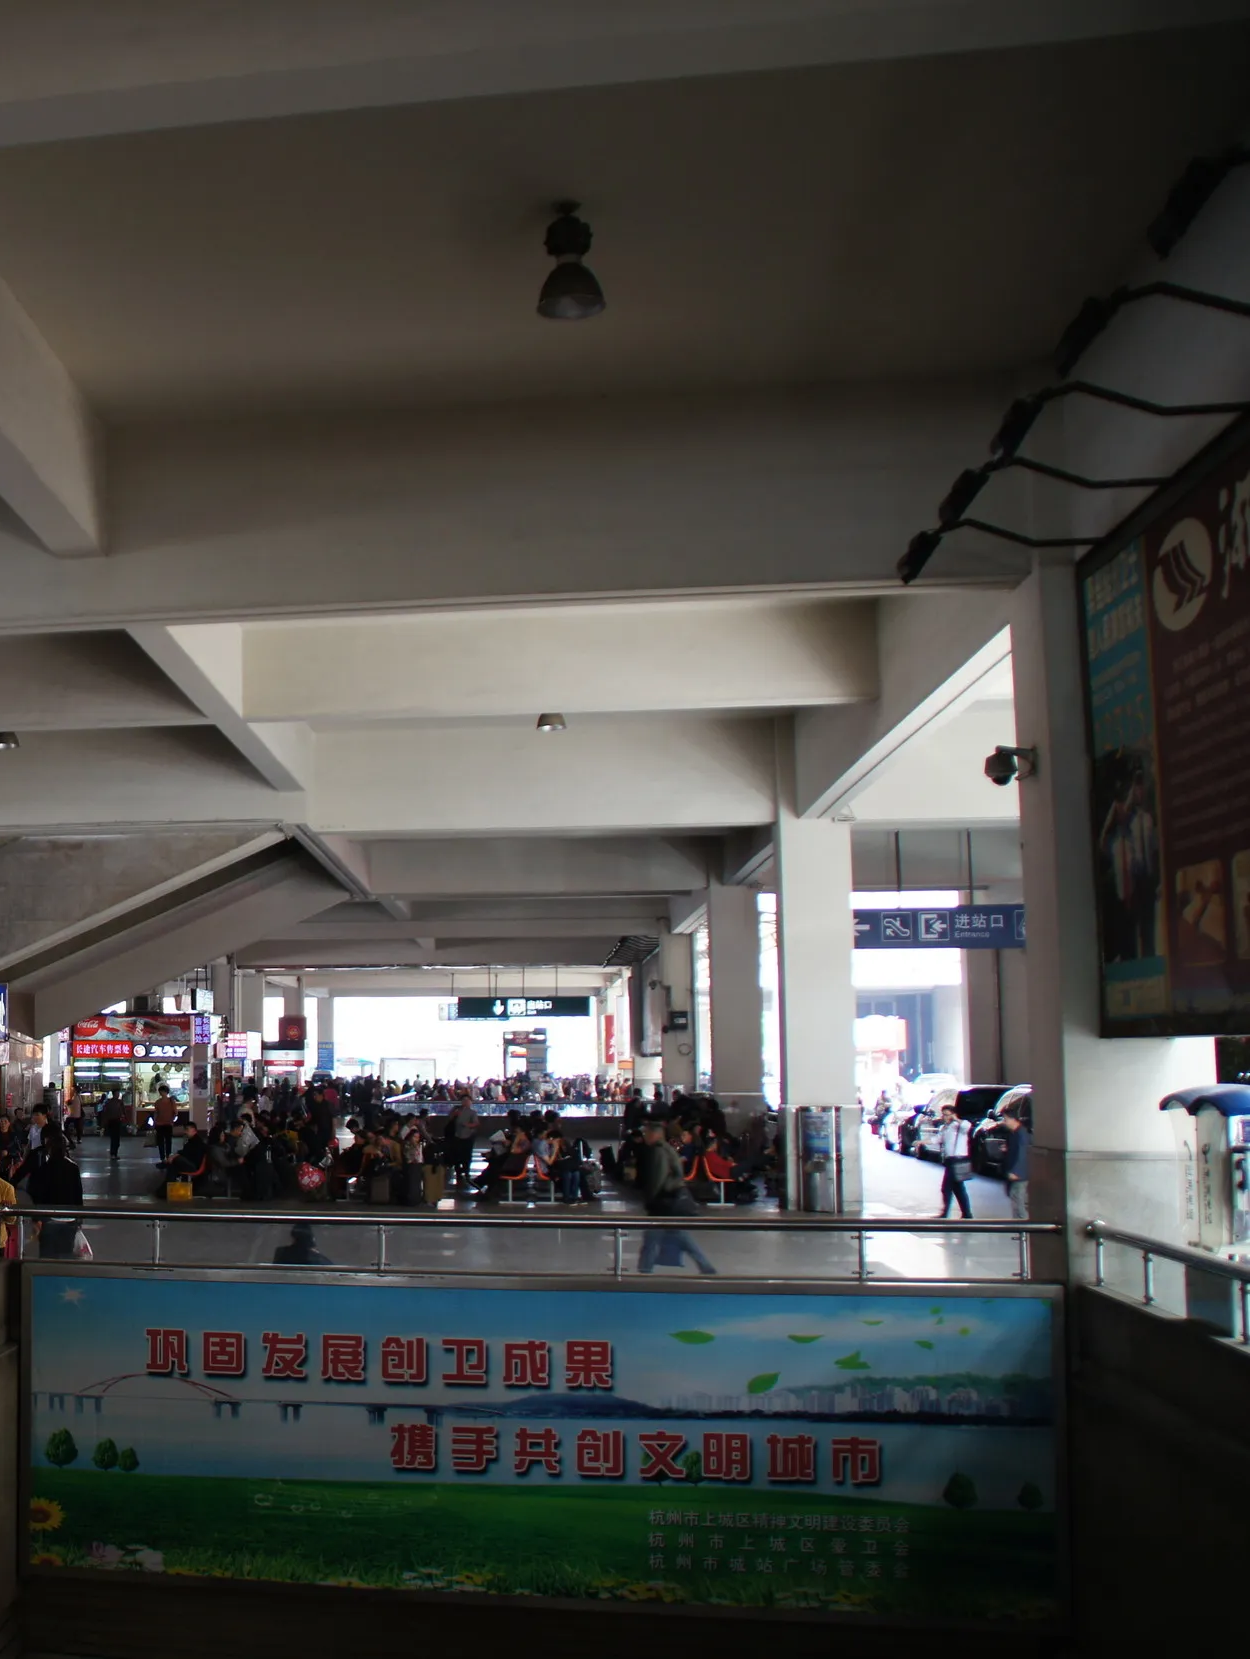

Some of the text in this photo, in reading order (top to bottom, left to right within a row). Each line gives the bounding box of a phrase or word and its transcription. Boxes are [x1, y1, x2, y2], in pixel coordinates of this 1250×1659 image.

[954, 913, 1004, 929] 进站口
[75, 1043, 130, 1055] 长途汽车售票处
[145, 1327, 613, 1389] 巩固发展创卫成果
[390, 1422, 882, 1485] 携手共创文明城市
[648, 1509, 910, 1533] 杭州市上城区精神文明建设委员会
[648, 1533, 910, 1557] 杭州市上城区爱卫会
[648, 1553, 910, 1579] 杭州市城站广场管委会
